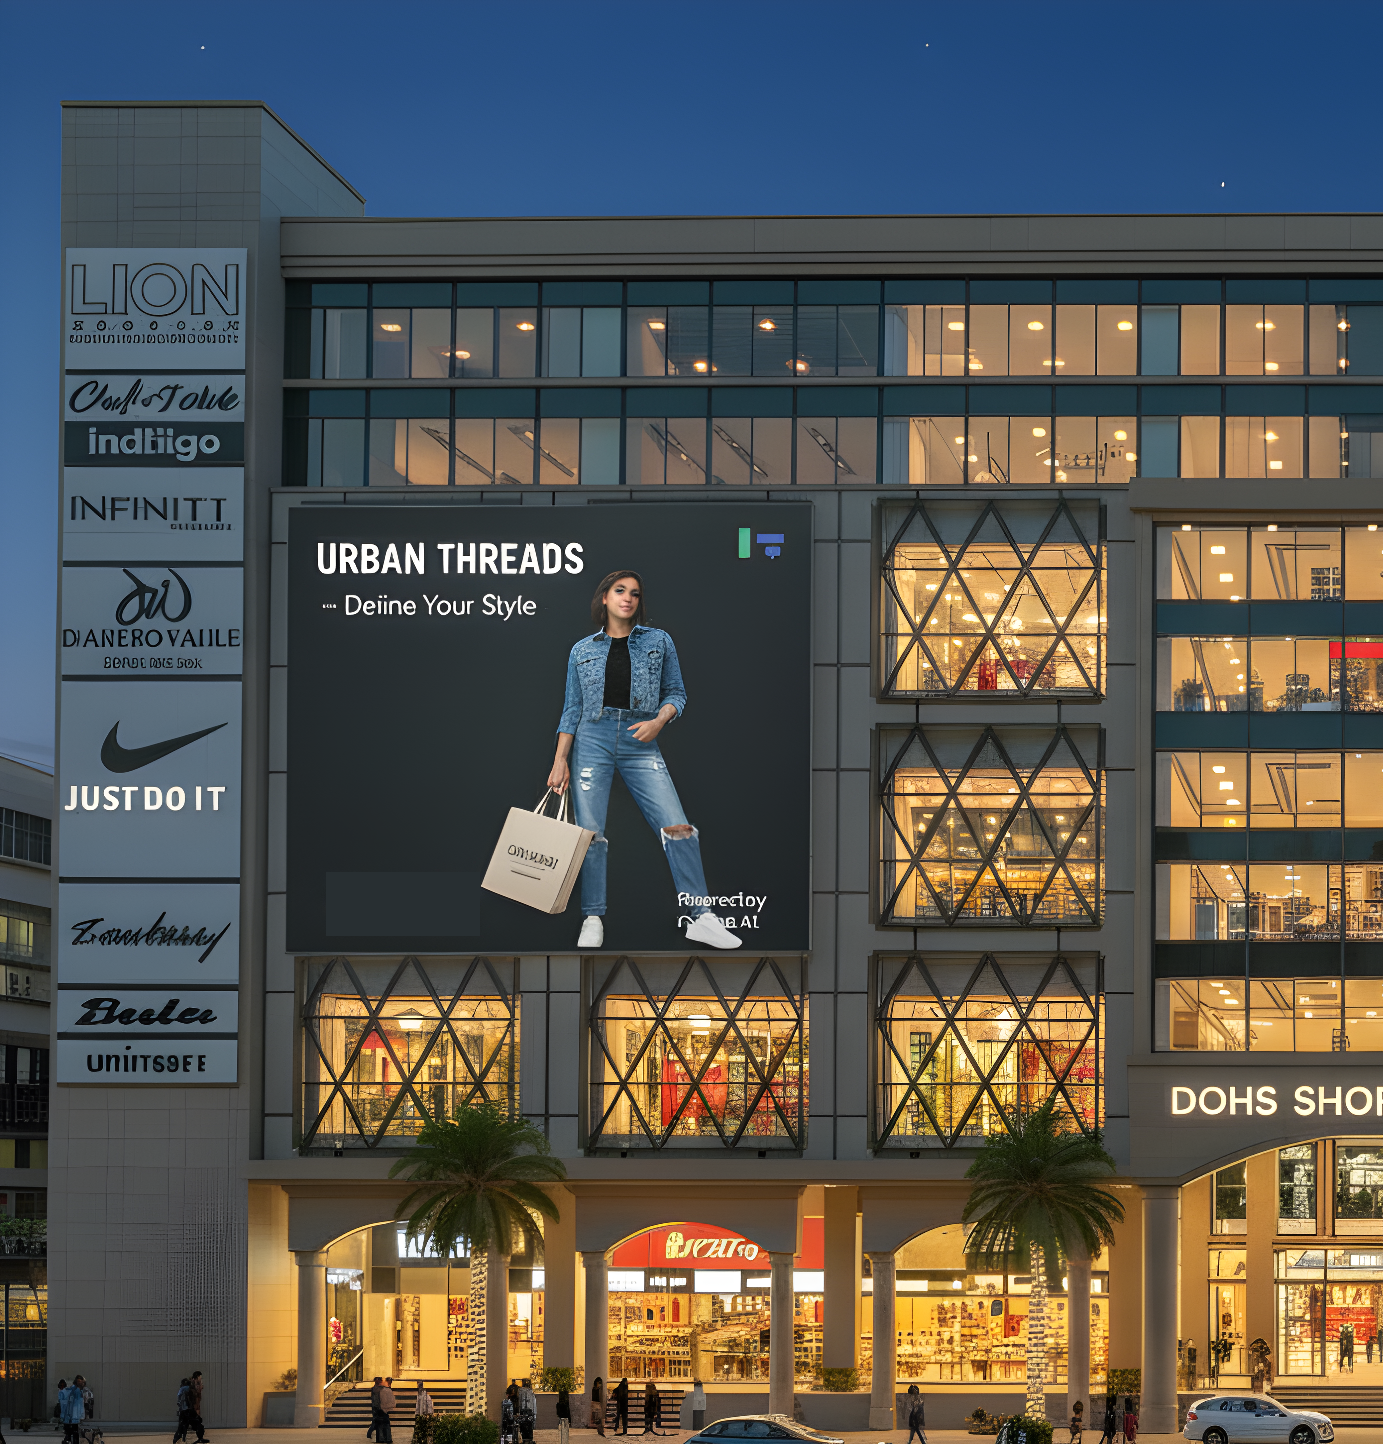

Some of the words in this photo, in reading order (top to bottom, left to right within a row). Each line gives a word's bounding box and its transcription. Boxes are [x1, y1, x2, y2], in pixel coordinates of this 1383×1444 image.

[71, 262, 240, 317] LION
[317, 541, 426, 576] URBAN
[436, 541, 585, 576] THREADS
[423, 593, 474, 616] Your
[482, 592, 537, 622] Style
[64, 785, 139, 811] JUST
[144, 786, 186, 811] DO
[195, 786, 226, 811] IT
[1171, 1086, 1278, 1116] DOHS
